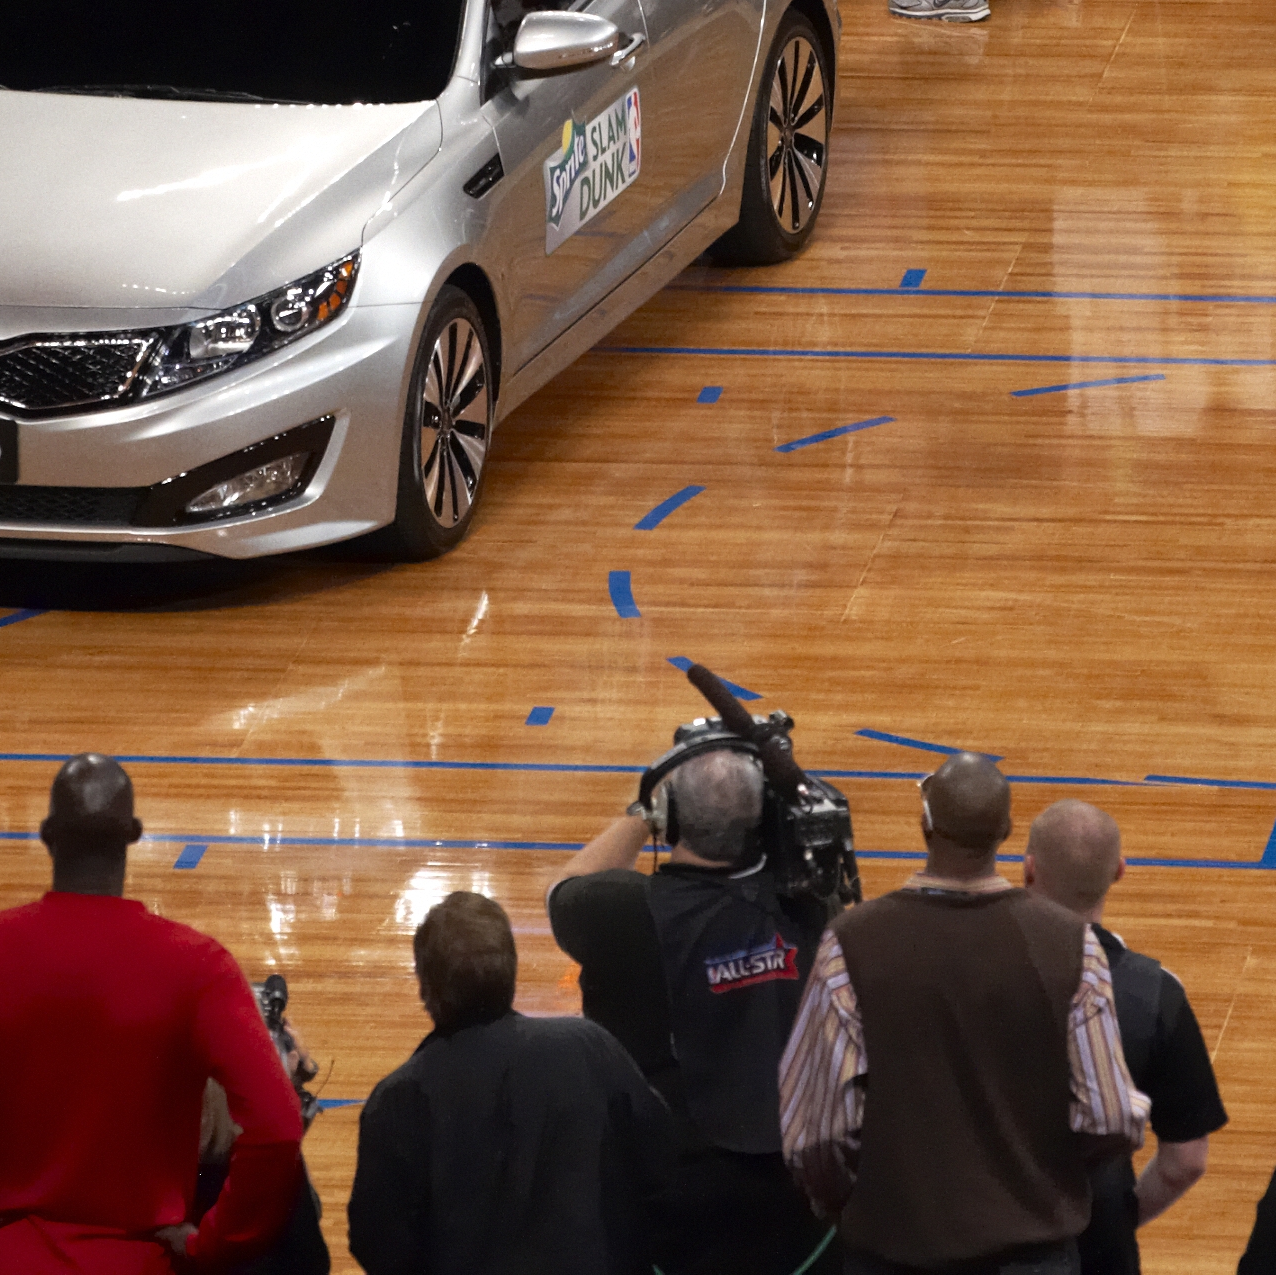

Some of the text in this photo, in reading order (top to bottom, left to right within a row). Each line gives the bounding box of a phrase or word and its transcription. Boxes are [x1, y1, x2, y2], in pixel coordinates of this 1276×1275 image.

[590, 102, 628, 163] SLAM
[551, 128, 587, 219] Sprite
[578, 142, 628, 223] DUNK
